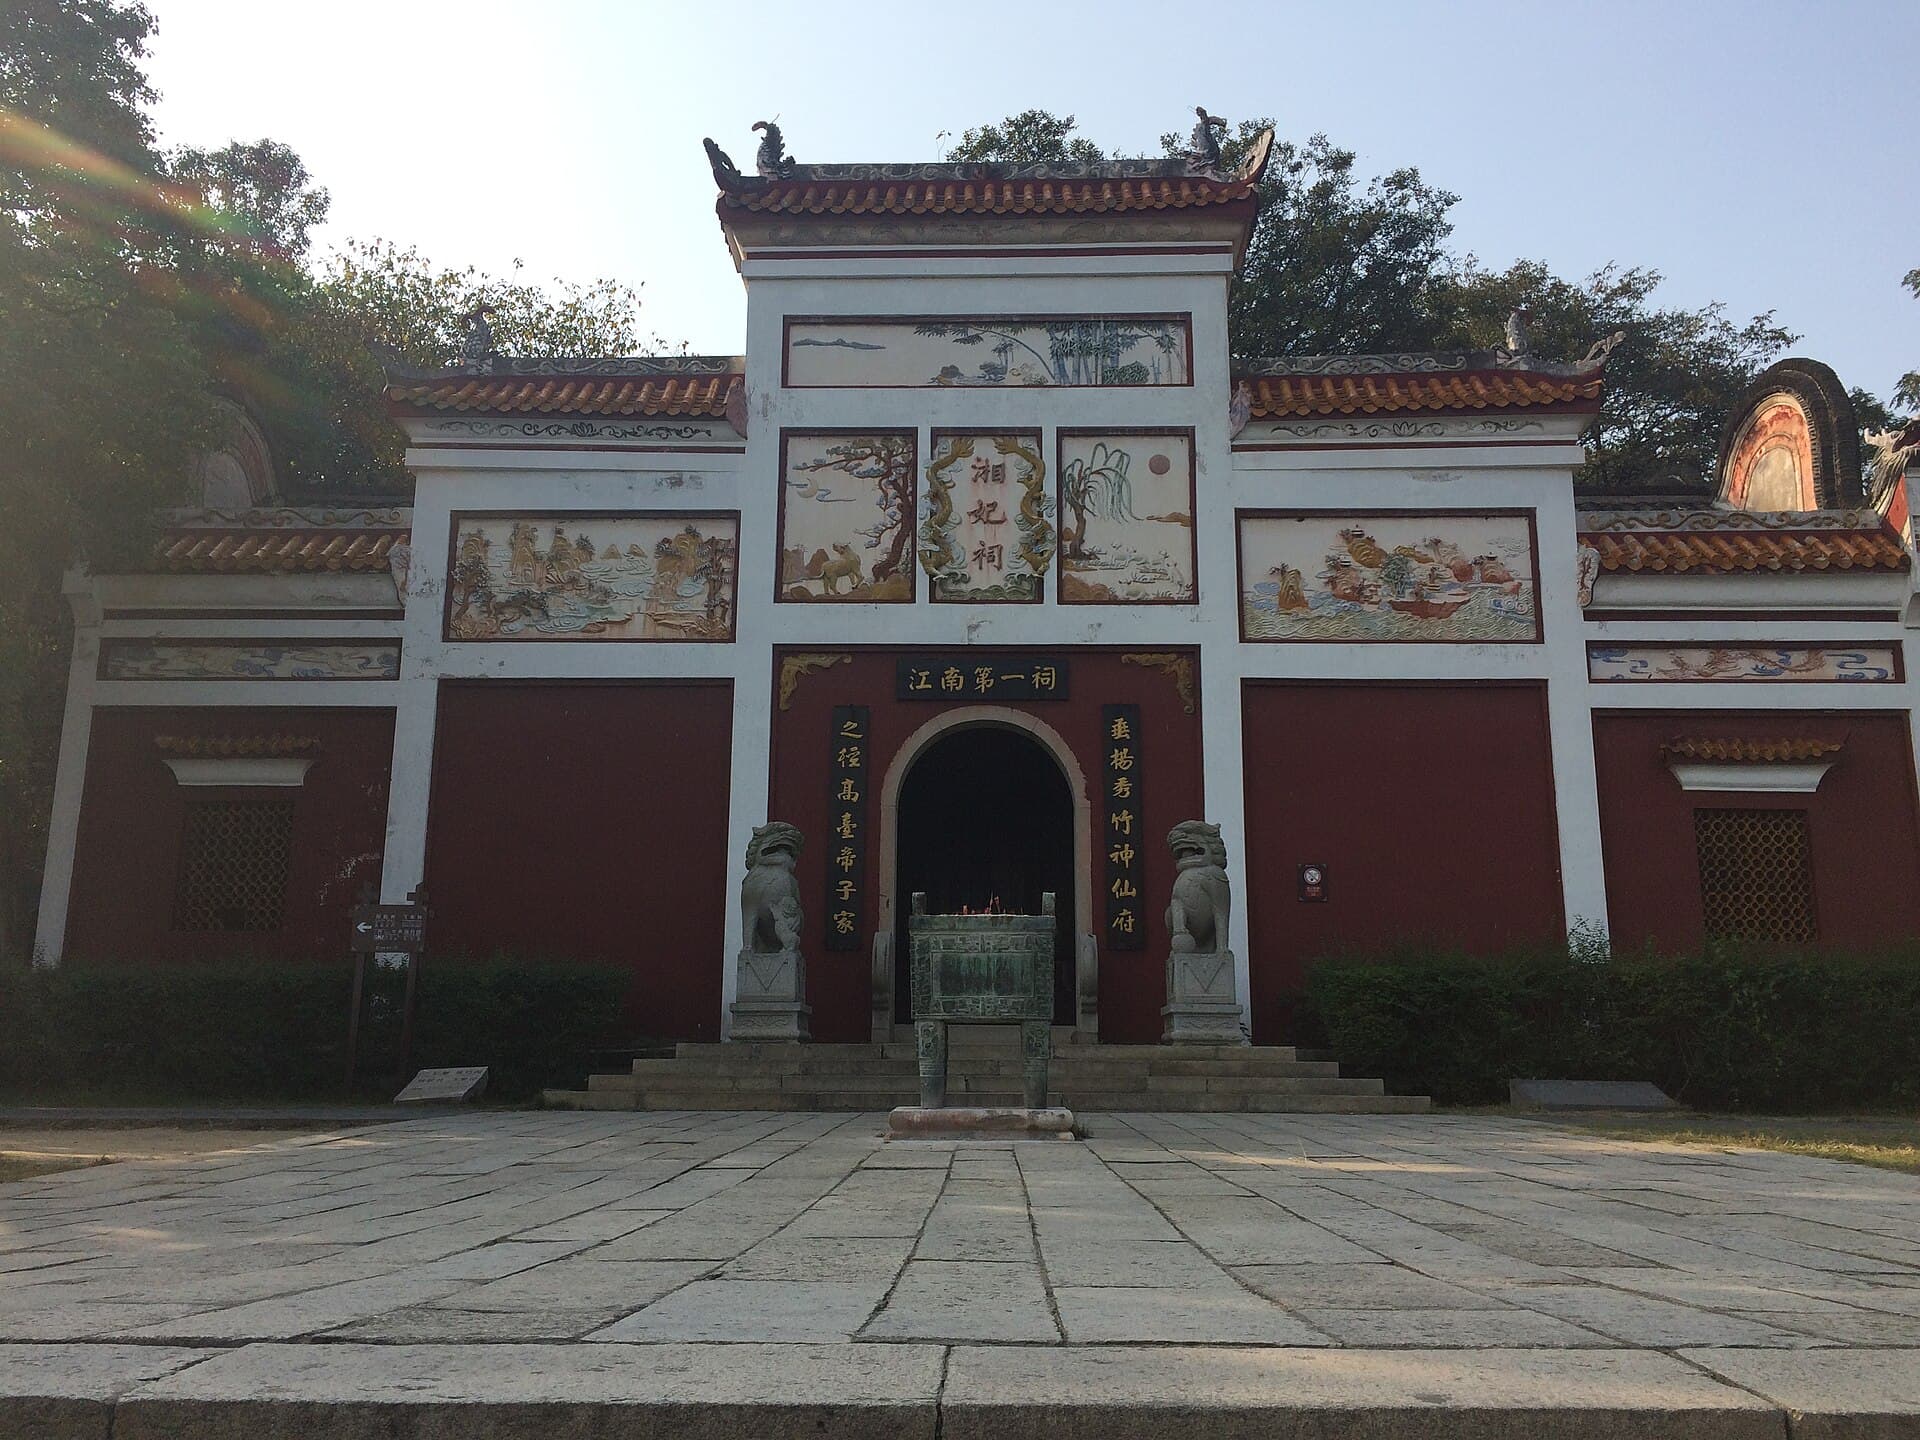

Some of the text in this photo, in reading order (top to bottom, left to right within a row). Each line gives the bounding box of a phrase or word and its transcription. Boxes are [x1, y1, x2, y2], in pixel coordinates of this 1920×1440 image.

[967, 455, 1007, 572] 湘妃祠
[908, 665, 1057, 695] 江南第一祠
